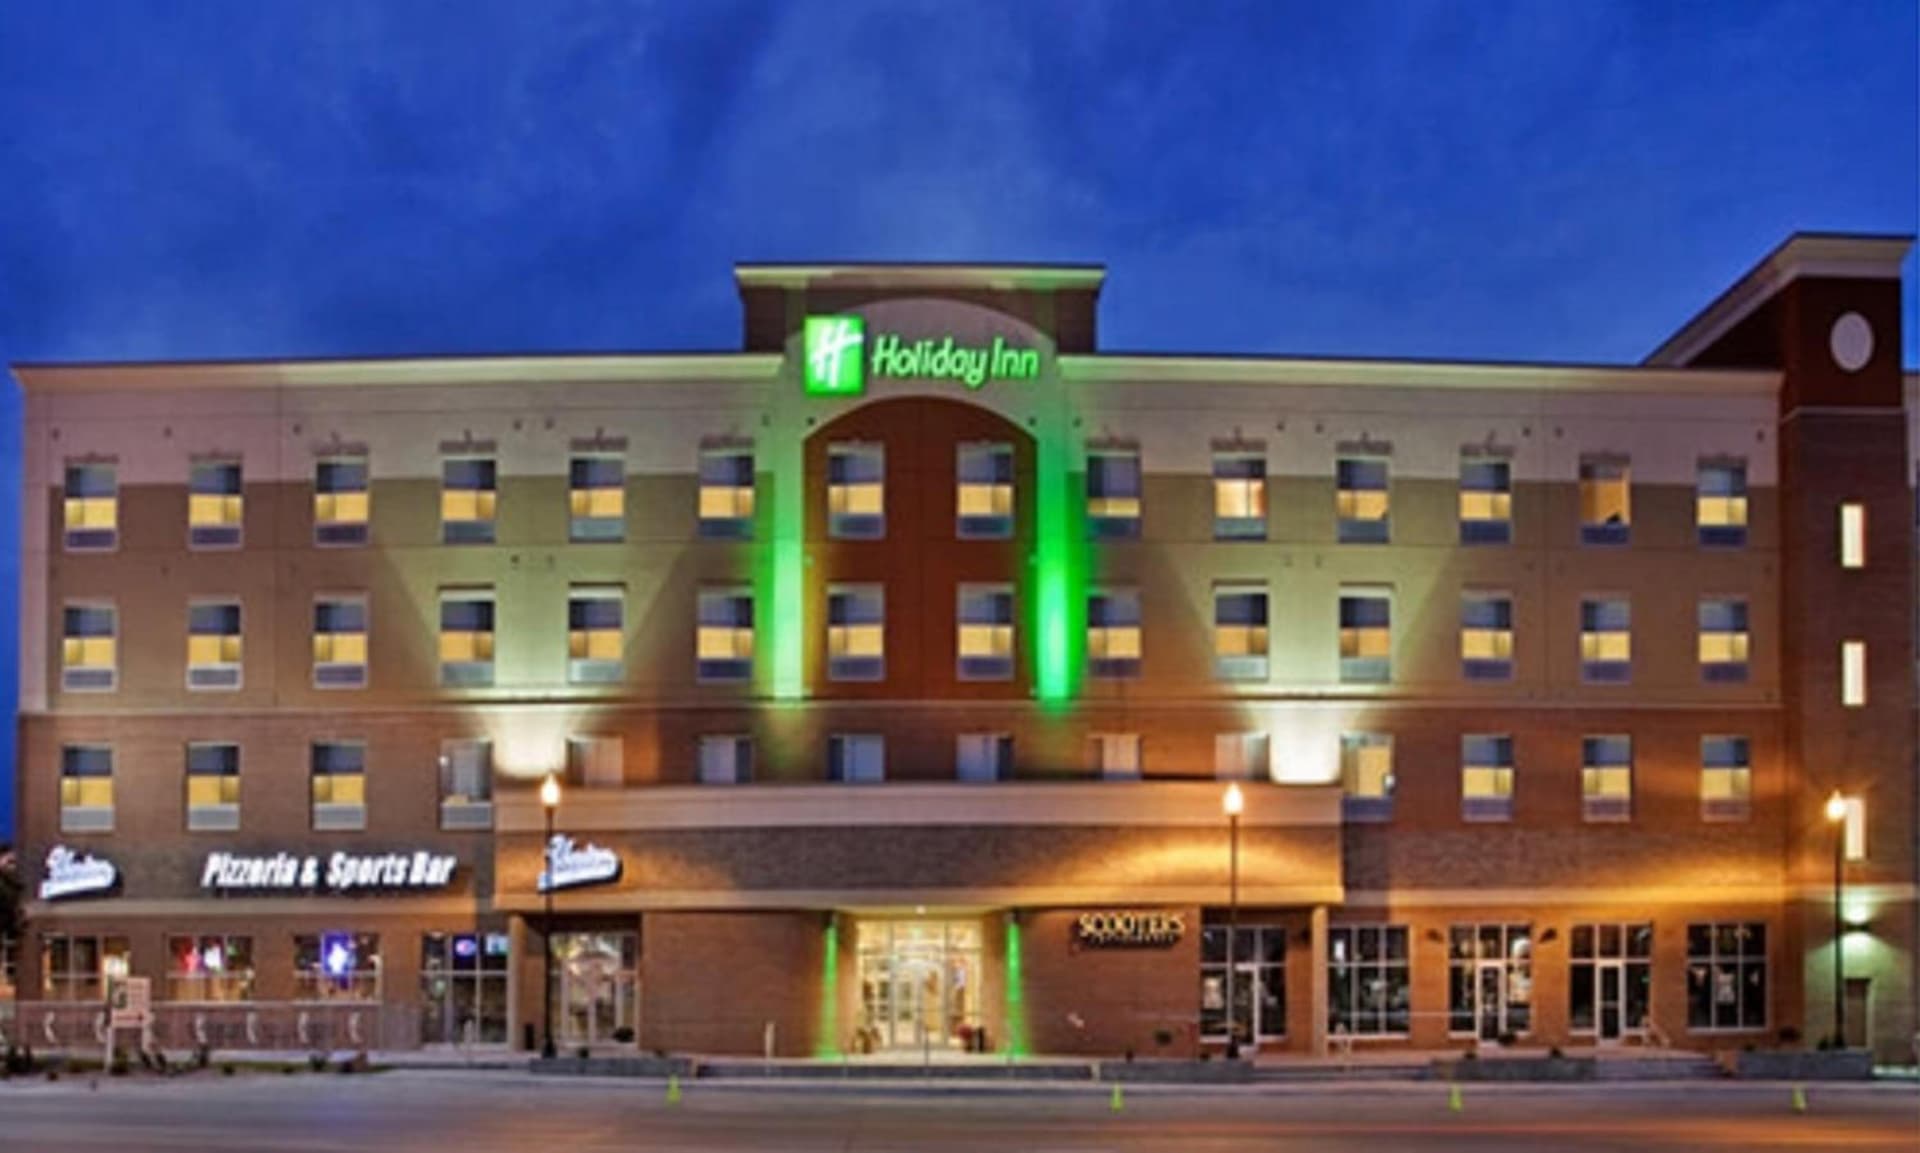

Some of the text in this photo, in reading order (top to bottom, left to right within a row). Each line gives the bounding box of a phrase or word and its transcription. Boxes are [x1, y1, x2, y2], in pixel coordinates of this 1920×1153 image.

[872, 334, 1039, 387] Holiday Inn
[201, 852, 456, 888] Pizzeria & Sports Bar
